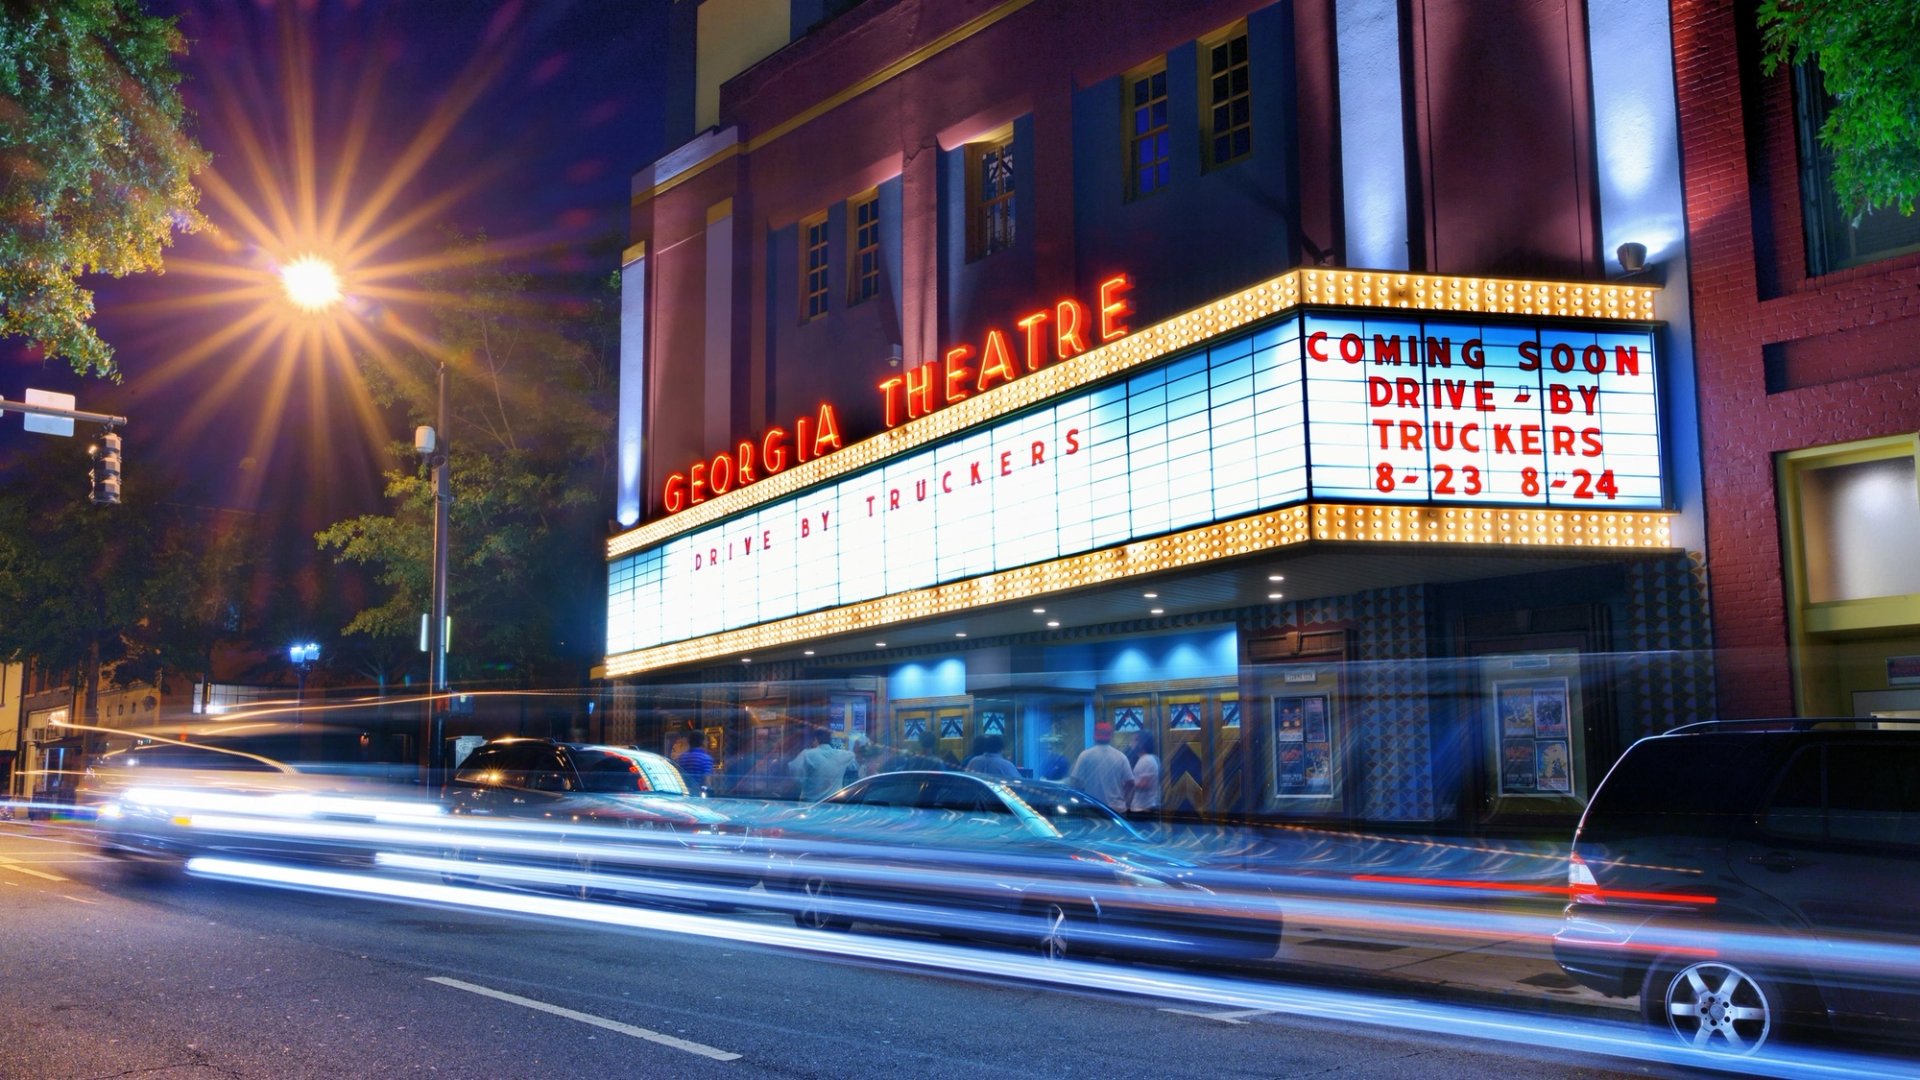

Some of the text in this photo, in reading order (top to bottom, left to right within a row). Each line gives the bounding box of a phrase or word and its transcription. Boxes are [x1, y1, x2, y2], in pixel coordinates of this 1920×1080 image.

[1306, 331, 1640, 377] COMING SOON
[664, 273, 1135, 513] GEORGIA THEATRE
[1368, 376, 1497, 412] DRIVE
[1372, 419, 1604, 458] TRUCKERS
[695, 428, 1081, 571] DRIVE BY TRUCKERS
[1375, 462, 1619, 500] 8-23 8-24
